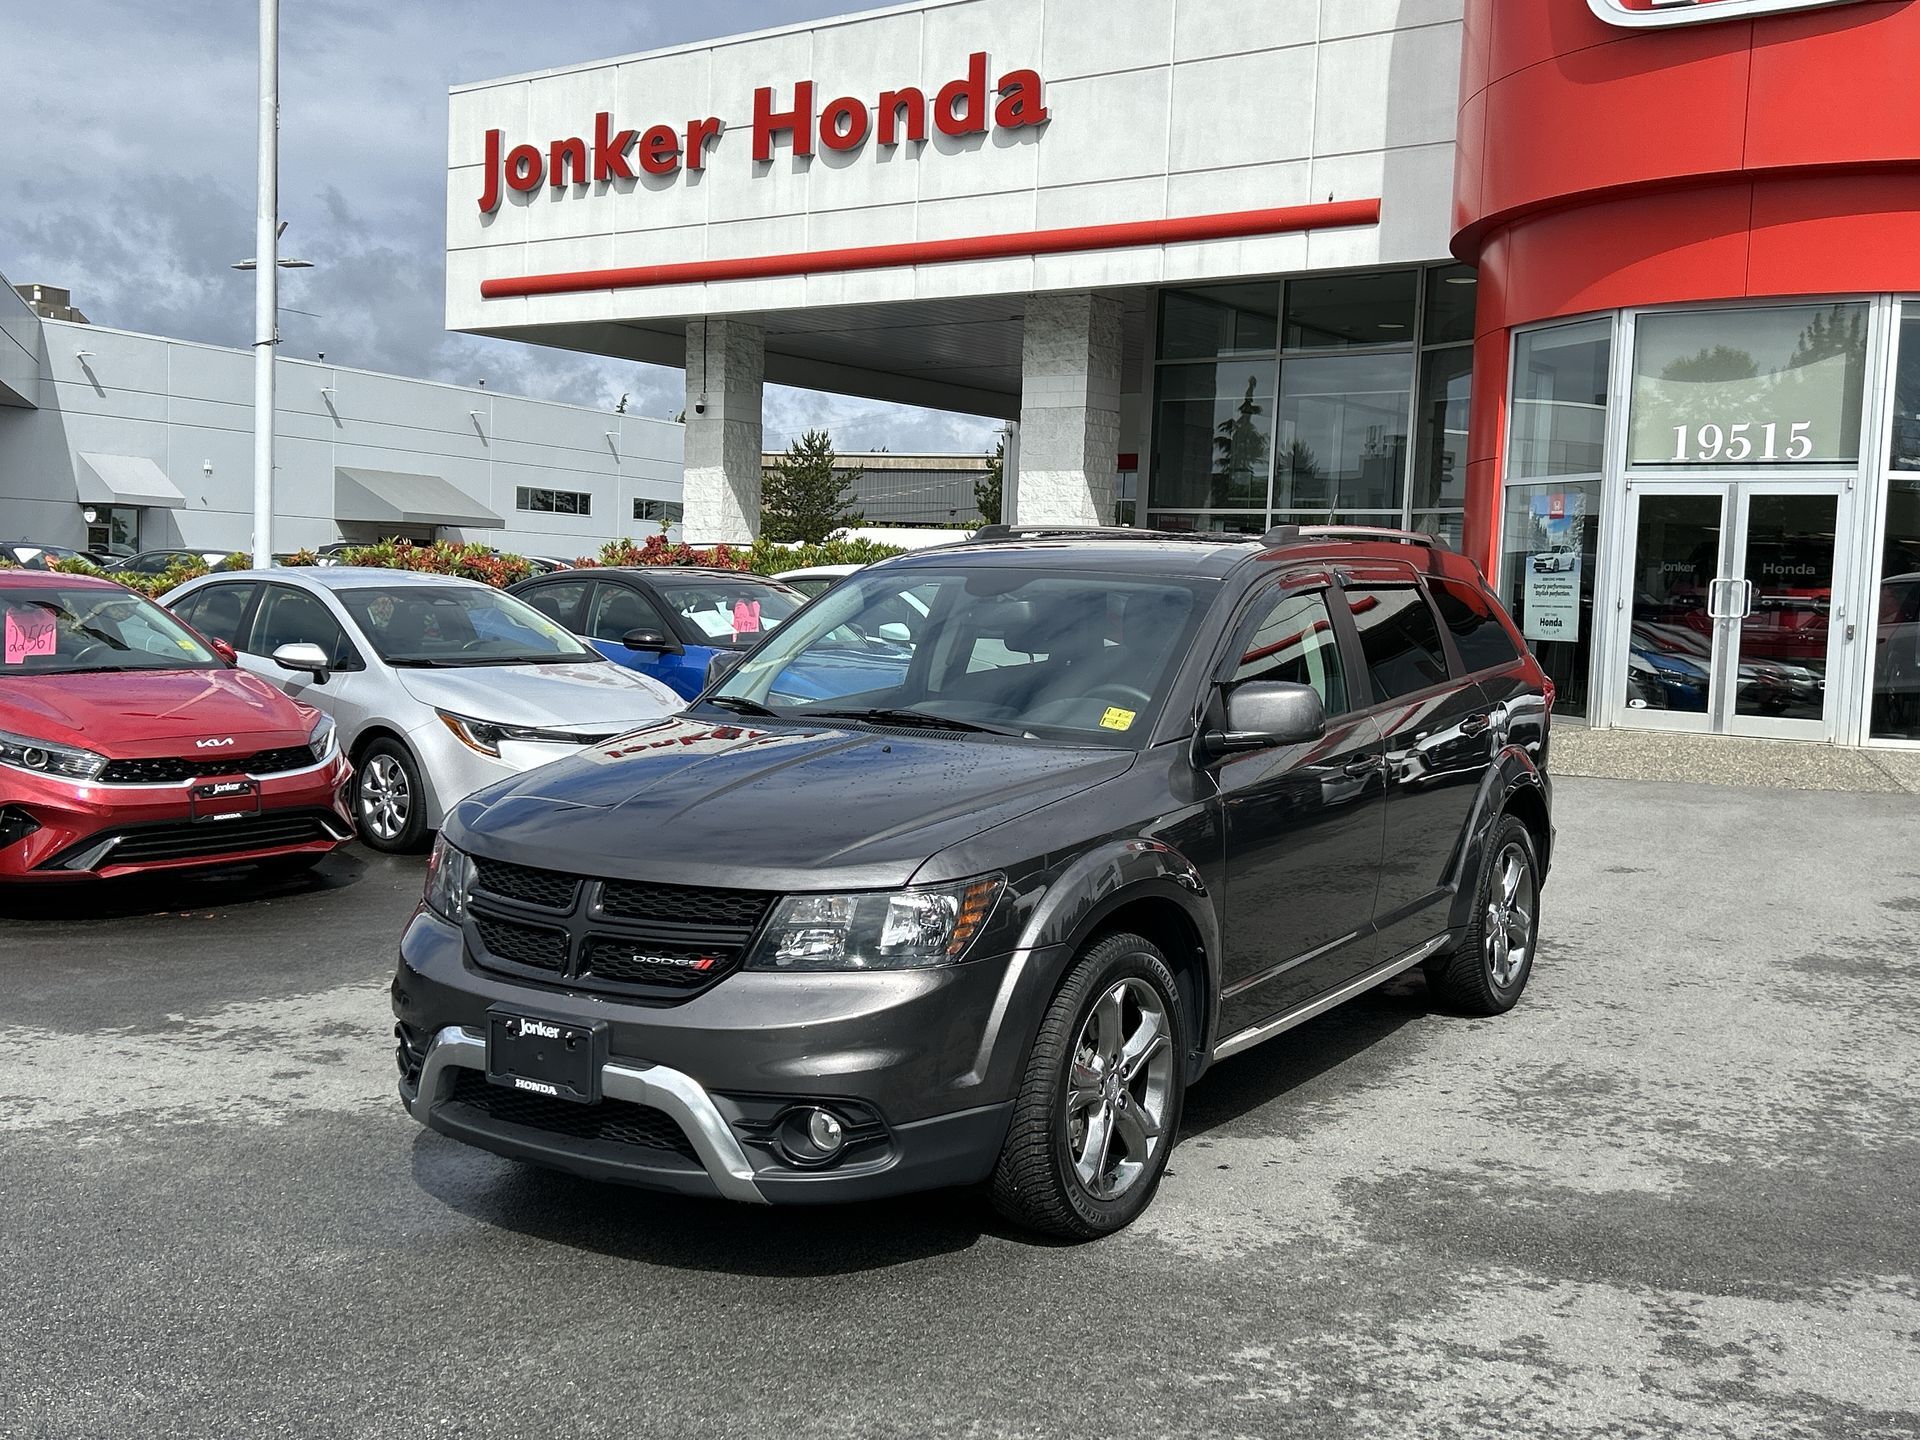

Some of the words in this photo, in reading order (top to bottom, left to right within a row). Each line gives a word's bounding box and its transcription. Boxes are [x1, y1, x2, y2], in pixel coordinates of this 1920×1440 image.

[478, 112, 723, 213] Jonker
[753, 52, 1049, 162] Honda
[1671, 421, 1812, 460] 19515
[1658, 561, 1696, 574] Jonker
[1763, 563, 1815, 575] Honda
[1540, 618, 1563, 627] Honda
[213, 783, 240, 794] Jonker
[519, 1018, 560, 1038] Jonker
[515, 1079, 558, 1095] HONDA
